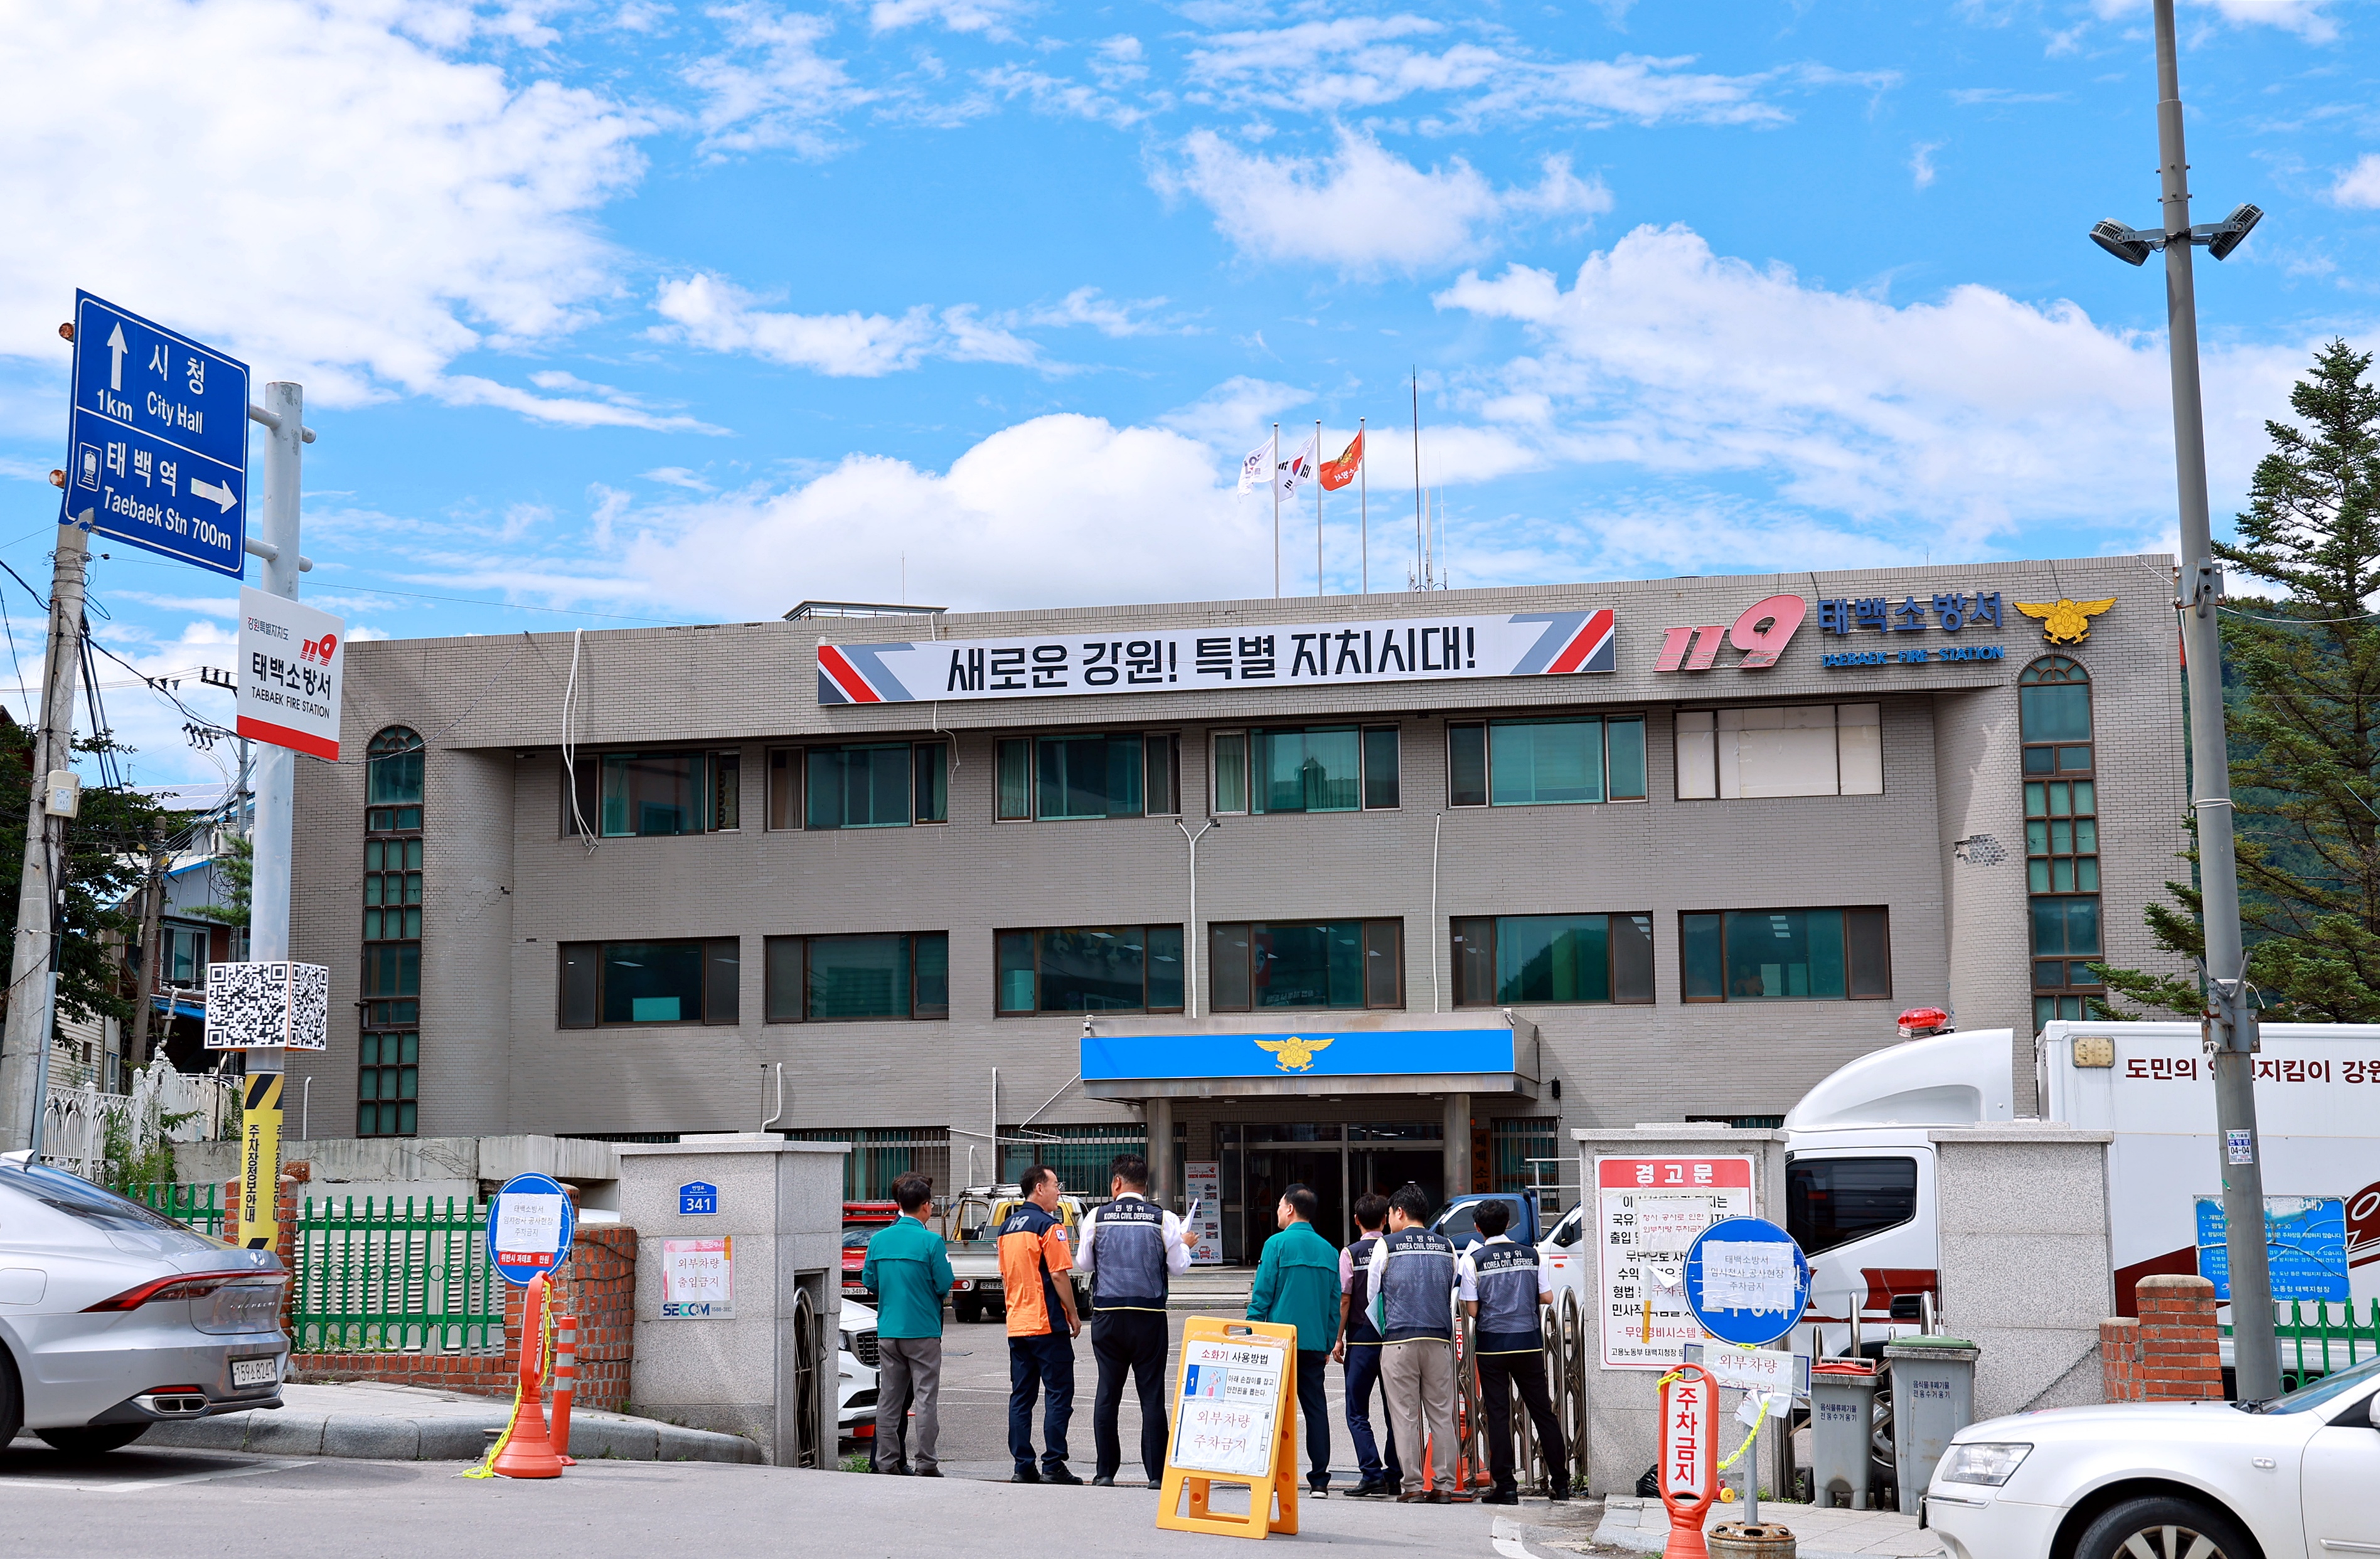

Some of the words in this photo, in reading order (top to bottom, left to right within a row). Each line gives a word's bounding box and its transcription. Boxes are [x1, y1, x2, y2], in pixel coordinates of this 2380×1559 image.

[149, 344, 205, 395] 시청
[97, 389, 132, 422] 1km
[147, 391, 174, 427] City
[177, 402, 203, 434] Hall
[107, 442, 177, 497] 태백역
[104, 486, 163, 528] Taebaek
[165, 508, 188, 536] Stn
[192, 518, 232, 551] 700m
[1817, 591, 2002, 635] 태백소방서
[247, 617, 289, 641] 강원특별자치도
[1652, 593, 1807, 673] 119
[300, 634, 337, 667] 119
[1820, 651, 1887, 668] TAEBAEK
[1898, 649, 1929, 664] FIRE
[1939, 645, 2004, 662] STATION
[947, 645, 1068, 693] 새로운
[1083, 641, 1178, 686] 강원!
[1195, 636, 1277, 679] 특별
[1291, 628, 1475, 678] 자치시대!
[252, 652, 332, 700] 태백소방서
[252, 686, 284, 706] TAEBAEK
[286, 696, 300, 710] FIRE
[302, 701, 330, 719] STATION
[2125, 1057, 2197, 1081] 도민의
[2208, 1058, 2330, 1083] 지킴이
[2231, 1146, 2249, 1154] 04-04
[244, 1124, 260, 1223] 주차장정보안내
[1635, 1164, 1714, 1184] 경고문
[686, 1198, 710, 1211] 341
[1006, 1215, 1030, 1232] 119
[1104, 1212, 1120, 1220] KOREA
[1133, 1213, 1155, 1221] DEFENSE
[1613, 1214, 1638, 1226] 국유
[1609, 1232, 1631, 1245] 출입
[1395, 1243, 1412, 1251] KOREA
[1426, 1243, 1446, 1251] DEFENSE
[501, 1253, 516, 1263] 위반시
[539, 1255, 550, 1264] 만원
[678, 1257, 720, 1269] 외부차량
[1483, 1260, 1501, 1270] KOREA
[1501, 1259, 1513, 1269] CIVIL
[1513, 1258, 1534, 1267] DEFENSE
[1724, 1255, 1769, 1265] 태백소방서
[1618, 1267, 1639, 1280] 수익
[1710, 1267, 1745, 1278] 임시청사
[1749, 1268, 1785, 1279] 공사현장
[678, 1276, 719, 1288] 출입금지
[1730, 1282, 1764, 1291] 주차금지
[2295, 1285, 2330, 1294] 태백지청장
[1613, 1285, 1635, 1299] 형법
[663, 1303, 710, 1316] SECOM
[1200, 1349, 1229, 1361] 소화기
[1231, 1351, 1269, 1365] 사용방법
[1611, 1348, 1643, 1356] 고용노동부
[1645, 1348, 1677, 1357] 태백지청장
[1719, 1354, 1778, 1375] 외부차량
[1190, 1377, 1195, 1387] 1
[1227, 1374, 1239, 1383] 아래
[1241, 1375, 1262, 1385] 손잡이를
[1263, 1378, 1274, 1386] 잡고
[1226, 1385, 1248, 1395] 안전핀을
[1249, 1386, 1267, 1397] 뽑는다.
[1197, 1410, 1251, 1429] 외부차량
[1194, 1433, 1247, 1454] 주차금지
[1674, 1386, 1699, 1486] 주차금지
